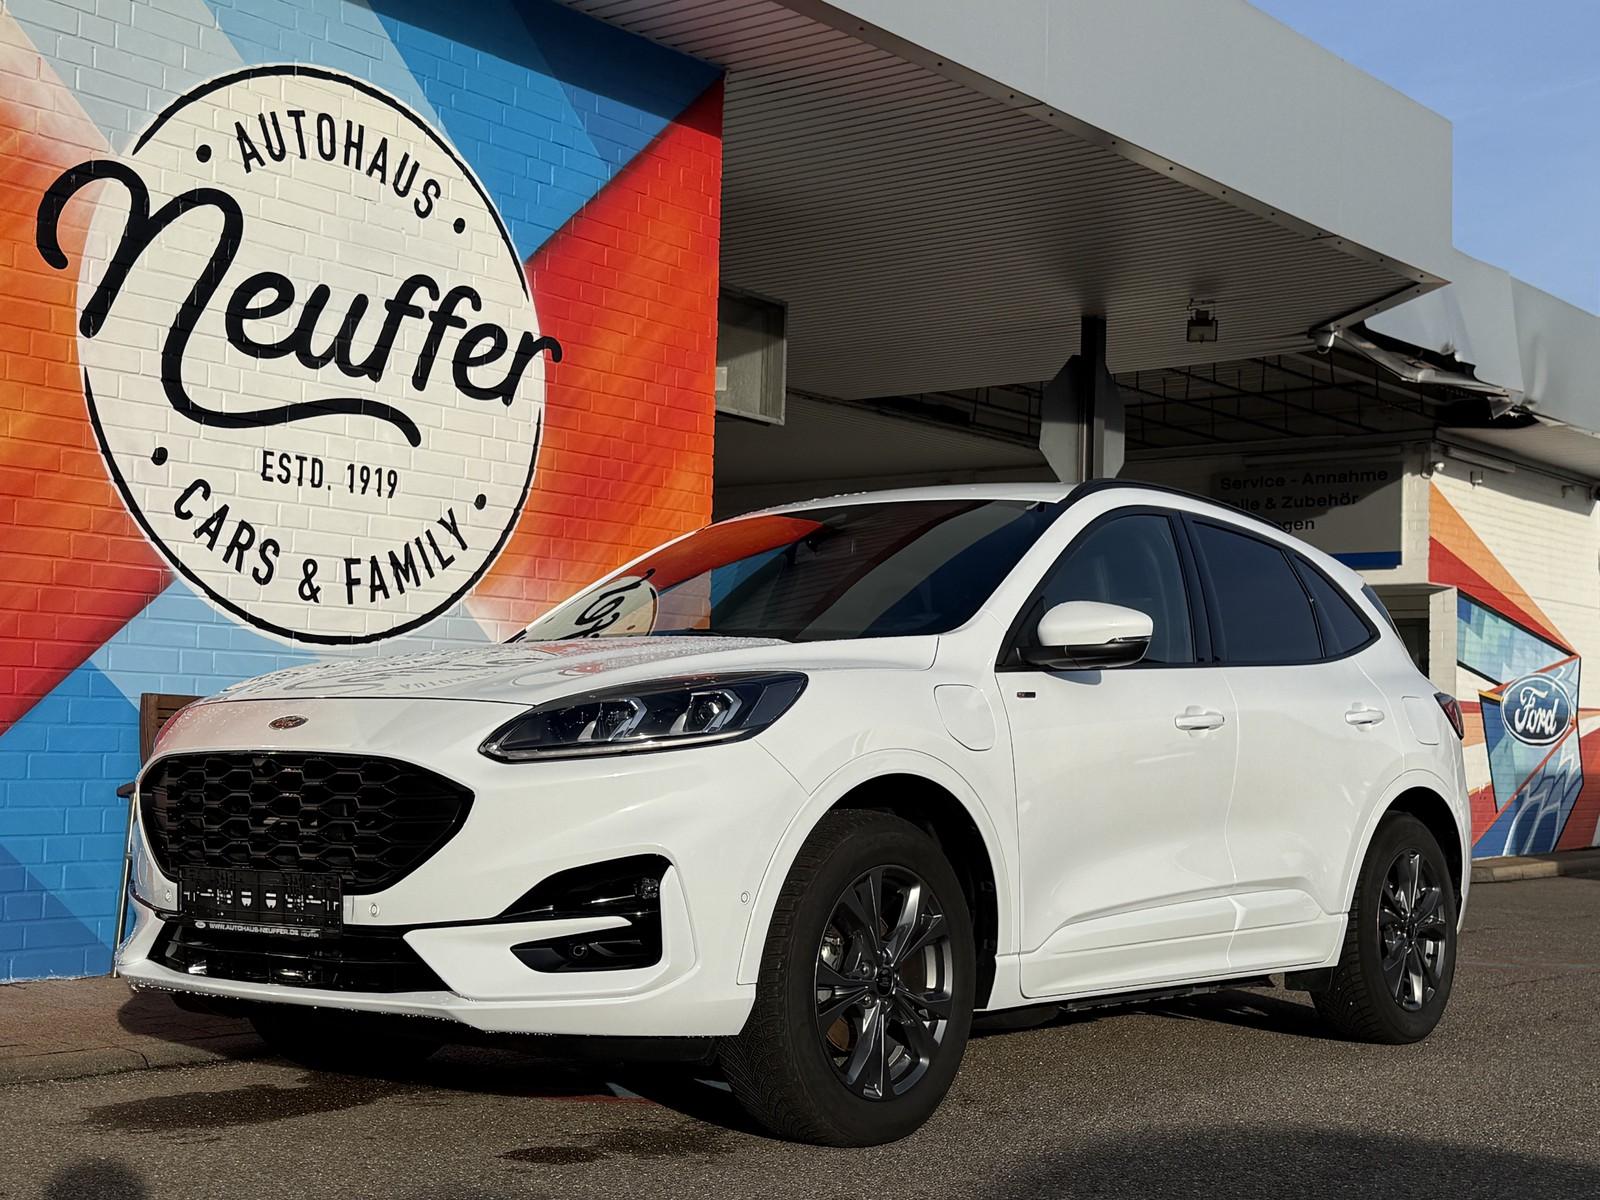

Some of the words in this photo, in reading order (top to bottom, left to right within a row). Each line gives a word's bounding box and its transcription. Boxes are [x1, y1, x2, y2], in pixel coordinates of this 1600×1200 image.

[233, 109, 442, 220] AUTOHAUS
[36, 159, 563, 448] Neuffer
[260, 450, 332, 490] ESTD.
[347, 463, 398, 499] 1919
[1220, 475, 1286, 490] Service
[1302, 469, 1388, 486] Annahme
[1265, 496, 1277, 510] &
[1281, 492, 1360, 509] Zubehör
[173, 478, 281, 586] CARS
[298, 558, 321, 604] &
[343, 507, 468, 605] FAMILY
[1514, 686, 1560, 735] Ford
